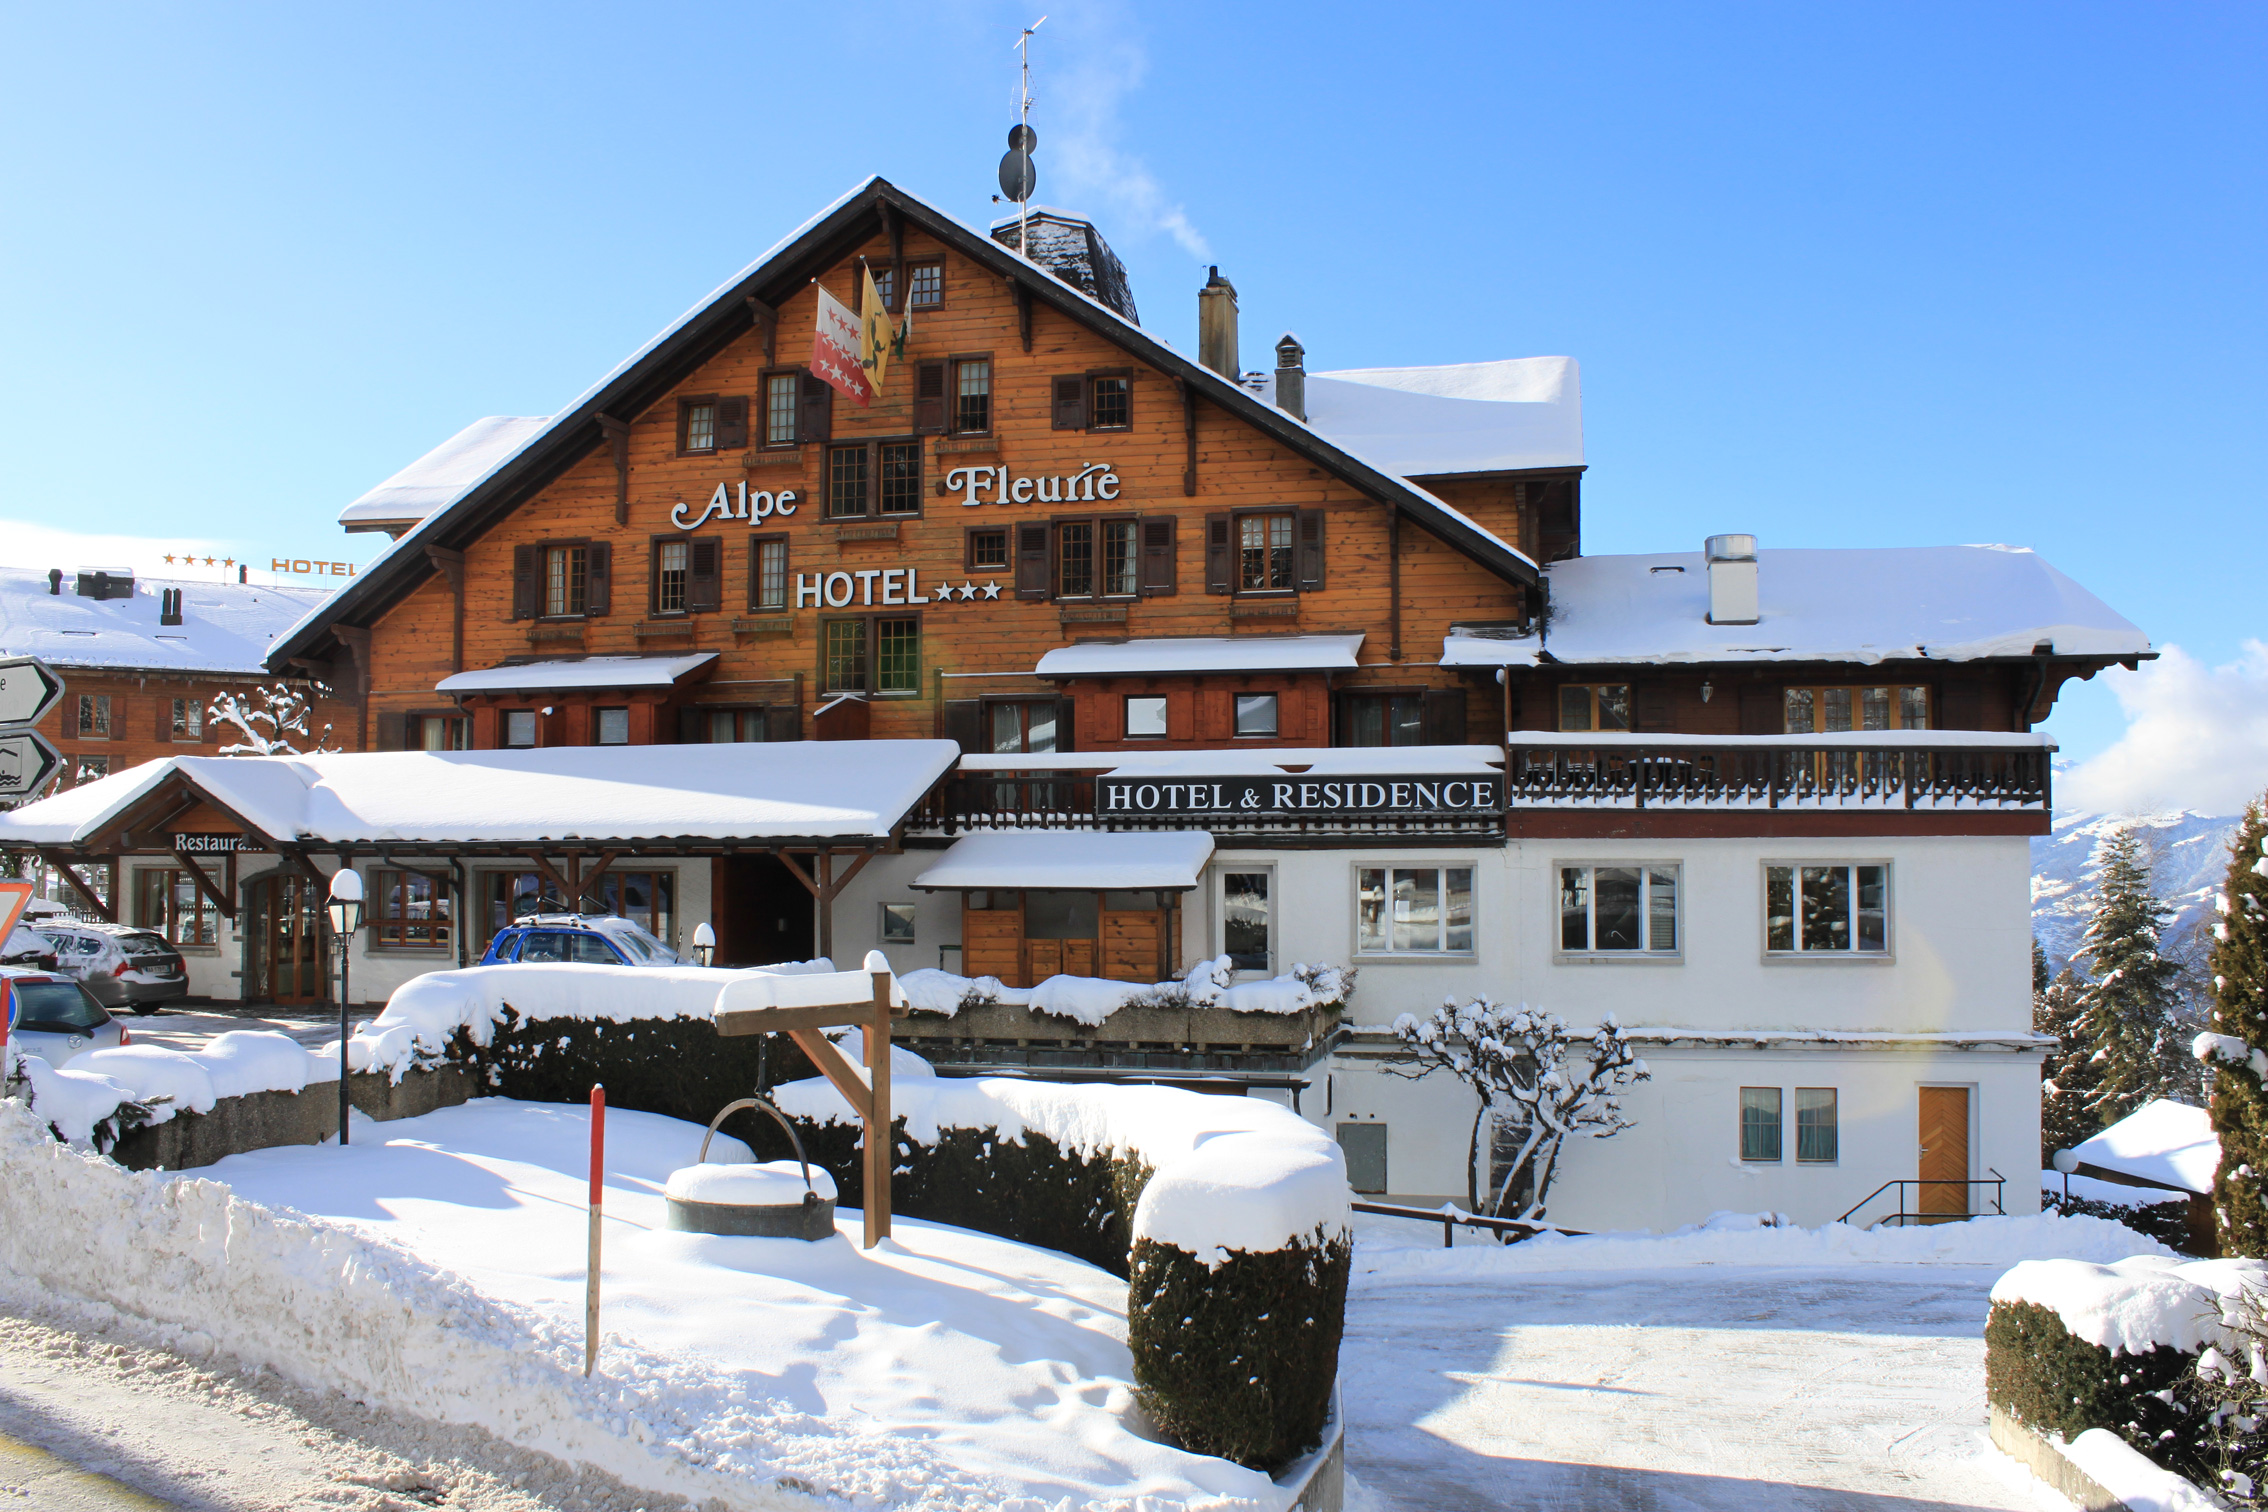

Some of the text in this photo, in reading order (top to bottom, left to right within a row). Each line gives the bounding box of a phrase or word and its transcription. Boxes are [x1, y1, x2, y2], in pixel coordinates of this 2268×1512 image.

[671, 461, 1120, 531] Alpe Fleurie
[271, 557, 358, 577] HOTEL
[796, 568, 930, 609] HOTEL
[1107, 781, 1495, 809] HOTEL & RESIDENCE
[175, 833, 264, 851] Restaura
